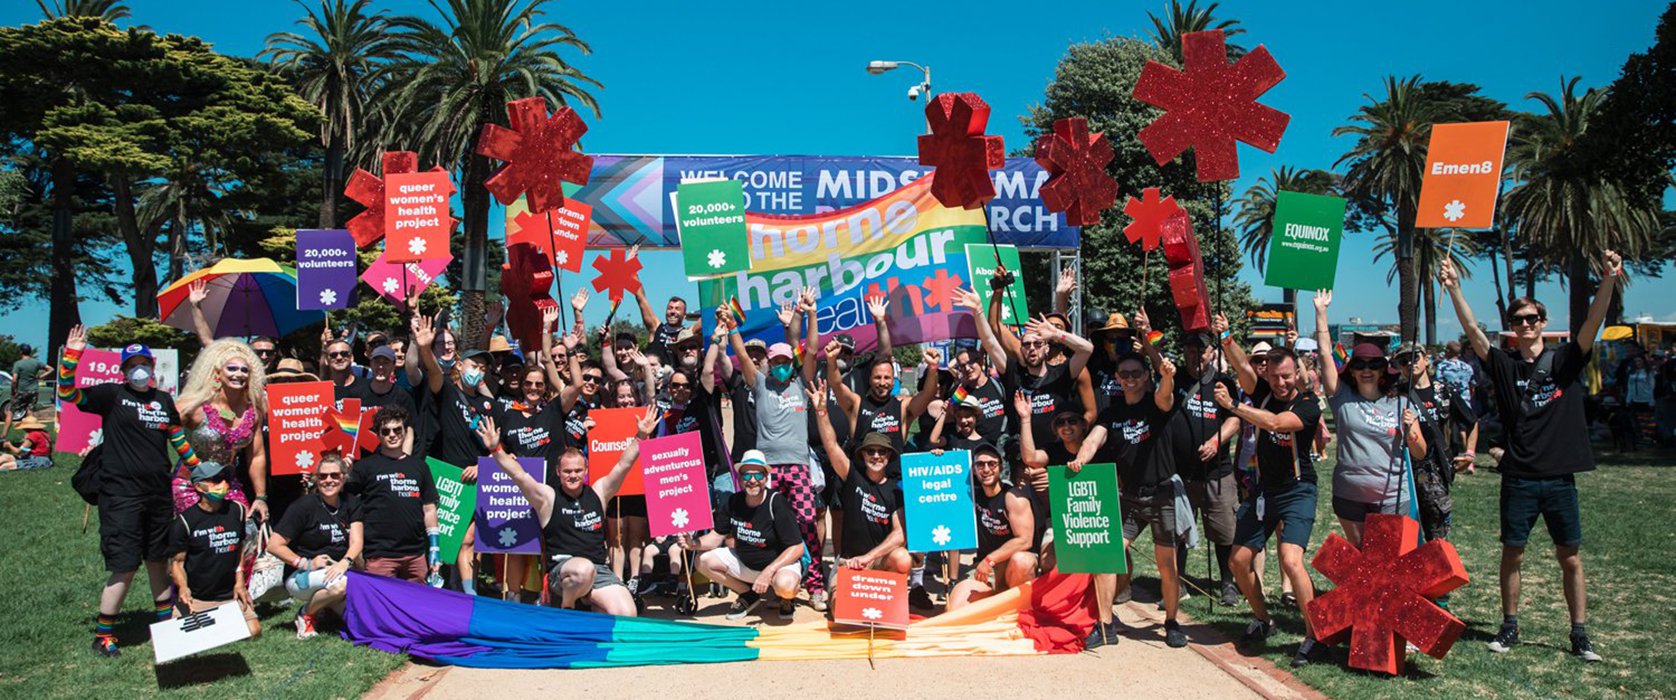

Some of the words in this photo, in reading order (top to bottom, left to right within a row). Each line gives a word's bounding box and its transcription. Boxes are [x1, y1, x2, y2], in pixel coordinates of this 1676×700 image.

[1431, 161, 1493, 175] Emen8
[399, 183, 435, 194] queer
[390, 194, 444, 205] women's
[756, 192, 803, 210] THE
[398, 206, 436, 216] health
[558, 207, 585, 221] drama
[688, 202, 736, 215] 20,000+
[395, 217, 440, 229] project
[682, 214, 744, 228] volunteers
[991, 206, 1058, 232] RCH
[750, 199, 918, 262] horne
[1285, 223, 1330, 241] EQUINOX
[304, 248, 348, 259] 20,000+
[298, 258, 354, 269] volunteers
[734, 228, 955, 313] harbour
[405, 262, 432, 285] ESH
[282, 393, 320, 405] queer
[282, 418, 322, 429] health
[651, 447, 690, 462] sexually
[643, 458, 702, 475] adventurous
[908, 464, 963, 477] HIV/AIDS
[436, 476, 464, 496] LGBTI
[659, 473, 689, 485] men's
[922, 478, 952, 491] legal
[481, 483, 522, 494] wome
[658, 484, 693, 499] project
[1068, 481, 1098, 497] LGBTI
[440, 493, 461, 512] mily
[489, 495, 530, 507] health
[918, 492, 958, 504] centre
[486, 507, 533, 521] project
[1066, 498, 1102, 516] Family
[437, 507, 461, 525] ence
[1062, 512, 1110, 529] Violence
[1066, 528, 1110, 548] Support
[851, 575, 897, 585] drama
[852, 583, 892, 593] down
[850, 591, 894, 601] under
